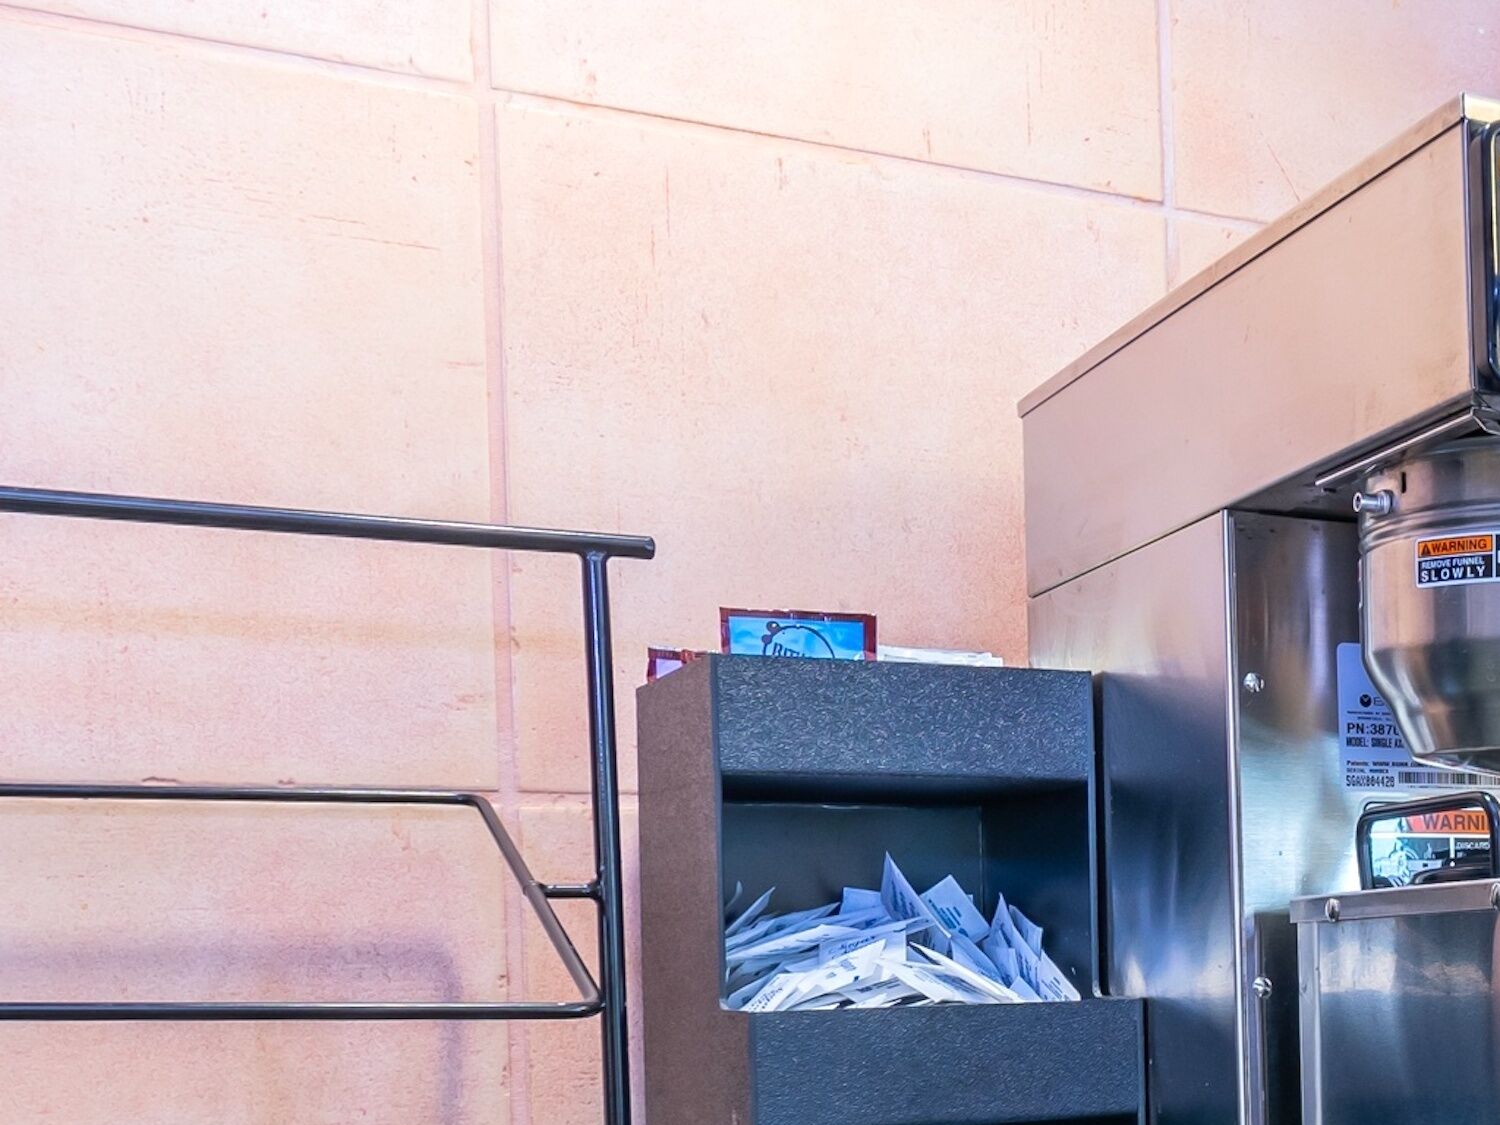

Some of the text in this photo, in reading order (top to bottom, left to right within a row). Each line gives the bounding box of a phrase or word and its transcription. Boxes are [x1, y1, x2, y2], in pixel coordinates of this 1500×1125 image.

[1432, 538, 1487, 552] WARNING
[1421, 555, 1485, 569] REMOVE FUNNEL
[1421, 564, 1486, 583] SLOWLY
